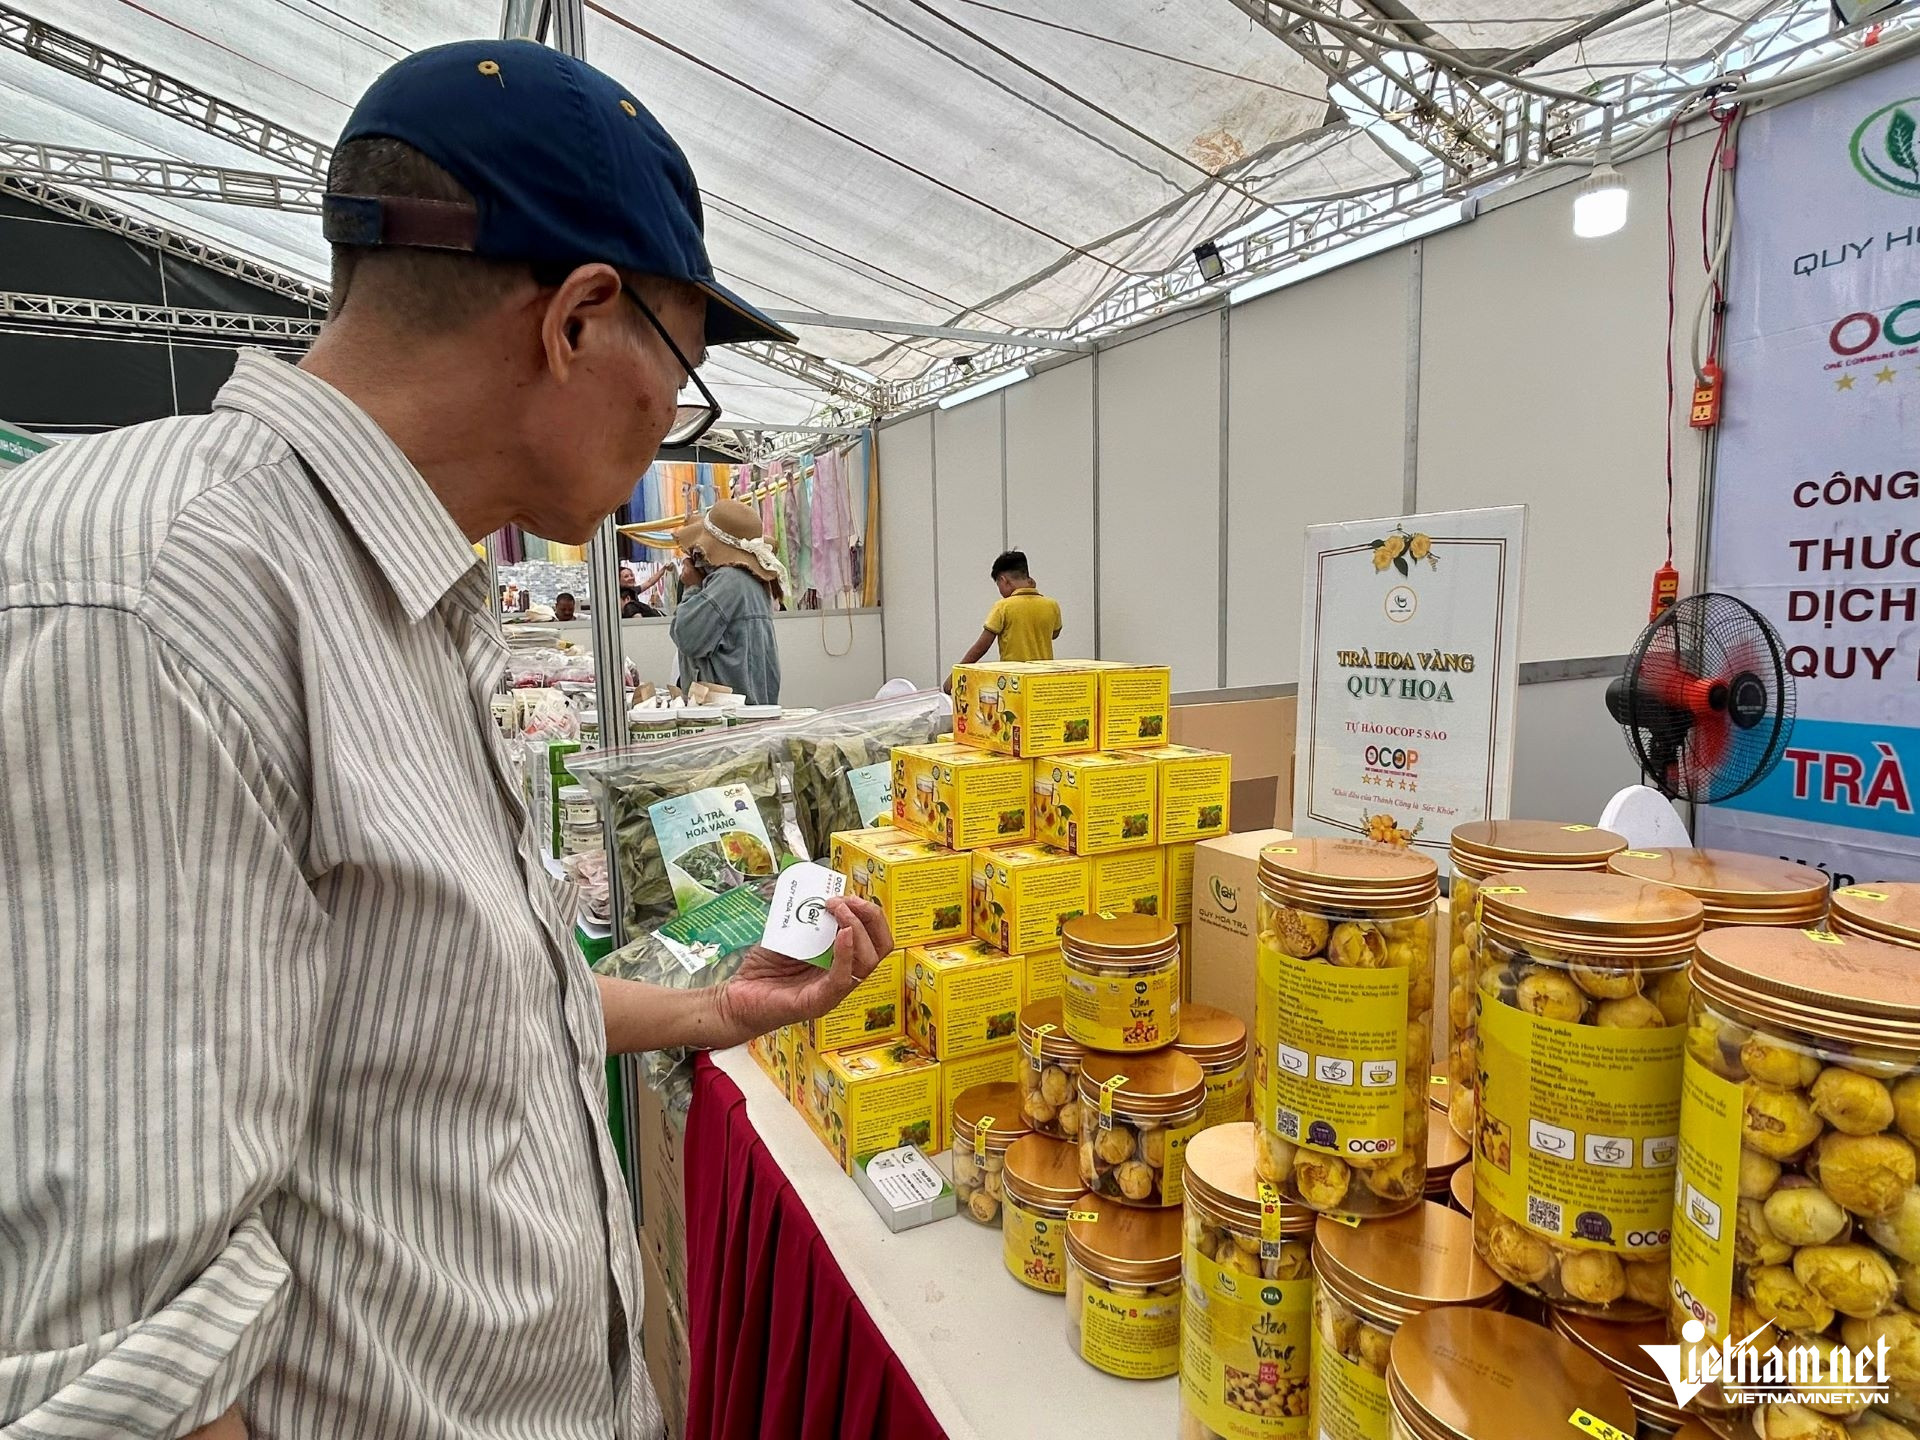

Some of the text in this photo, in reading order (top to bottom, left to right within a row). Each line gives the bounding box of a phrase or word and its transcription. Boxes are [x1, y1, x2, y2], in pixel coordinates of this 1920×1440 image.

[1793, 236, 1874, 276] QUY
[1793, 471, 1919, 508] CÔNG
[1788, 587, 1916, 628] DỊCH
[1337, 647, 1475, 673] TRÀ HOA VÀNG
[1785, 645, 1896, 680] QUY
[1347, 675, 1454, 702] QUY HOA
[1361, 722, 1383, 734] HÀO
[1386, 725, 1415, 738] OCOP
[1416, 729, 1423, 738] 5
[1424, 730, 1447, 741] SAO
[1365, 745, 1418, 770] OCOP
[1783, 742, 1913, 814] TRÀ
[686, 827, 709, 839] HOA
[1349, 1139, 1396, 1153] OCOP
[1262, 1291, 1280, 1301] TRÀ
[1674, 1279, 1717, 1326] OCOP
[1252, 1312, 1286, 1335] Hoa
